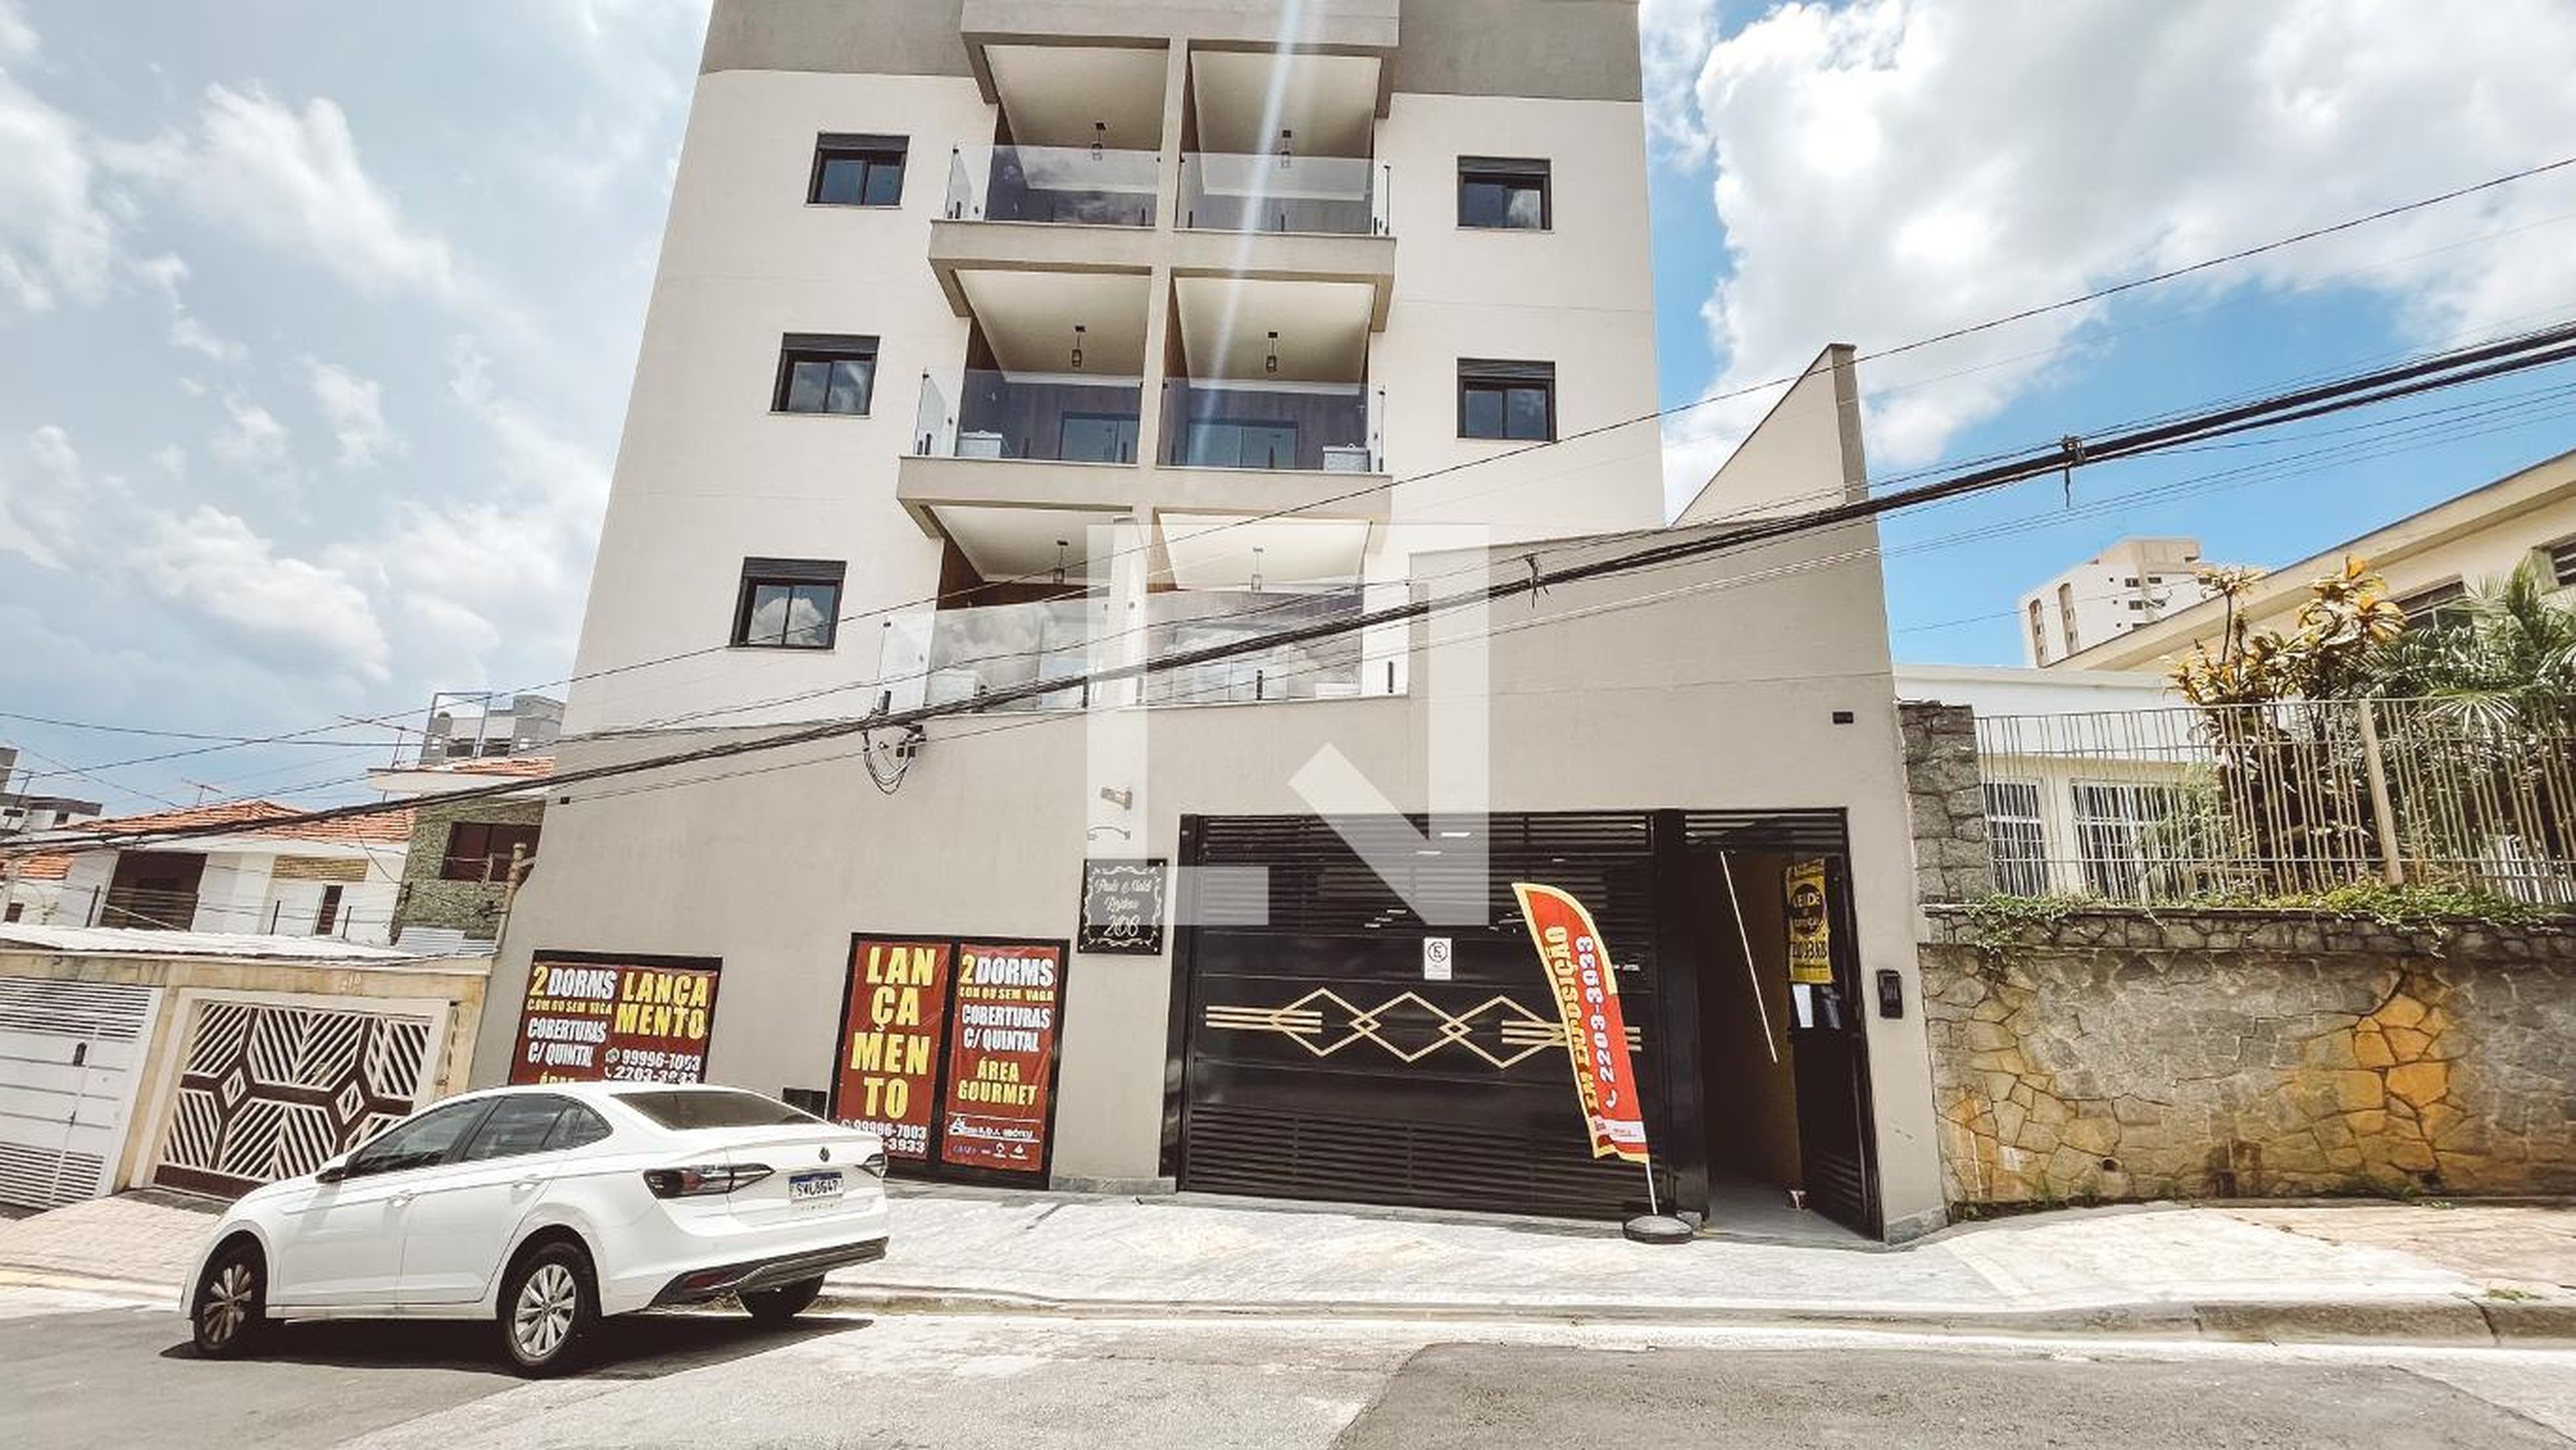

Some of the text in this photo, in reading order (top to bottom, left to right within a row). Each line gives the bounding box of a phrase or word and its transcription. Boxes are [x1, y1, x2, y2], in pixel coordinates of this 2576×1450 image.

[866, 947, 936, 986] LAN
[959, 953, 1054, 987] 2 DORMS
[530, 966, 618, 999] 2 DORMS
[998, 988, 1022, 1000] SEM
[615, 1003, 705, 1039] MENTO
[871, 985, 920, 1031] ÇA
[962, 1004, 1051, 1029] COBERTURAS
[527, 1017, 607, 1043] COBERTURAS
[964, 1027, 1039, 1052] C/ QUINTAL
[528, 1041, 547, 1064] C/
[850, 1032, 931, 1075] MEN
[977, 1056, 1020, 1082] ÁREA
[864, 1077, 908, 1119] TO
[957, 1080, 1038, 1106] GOURMET
